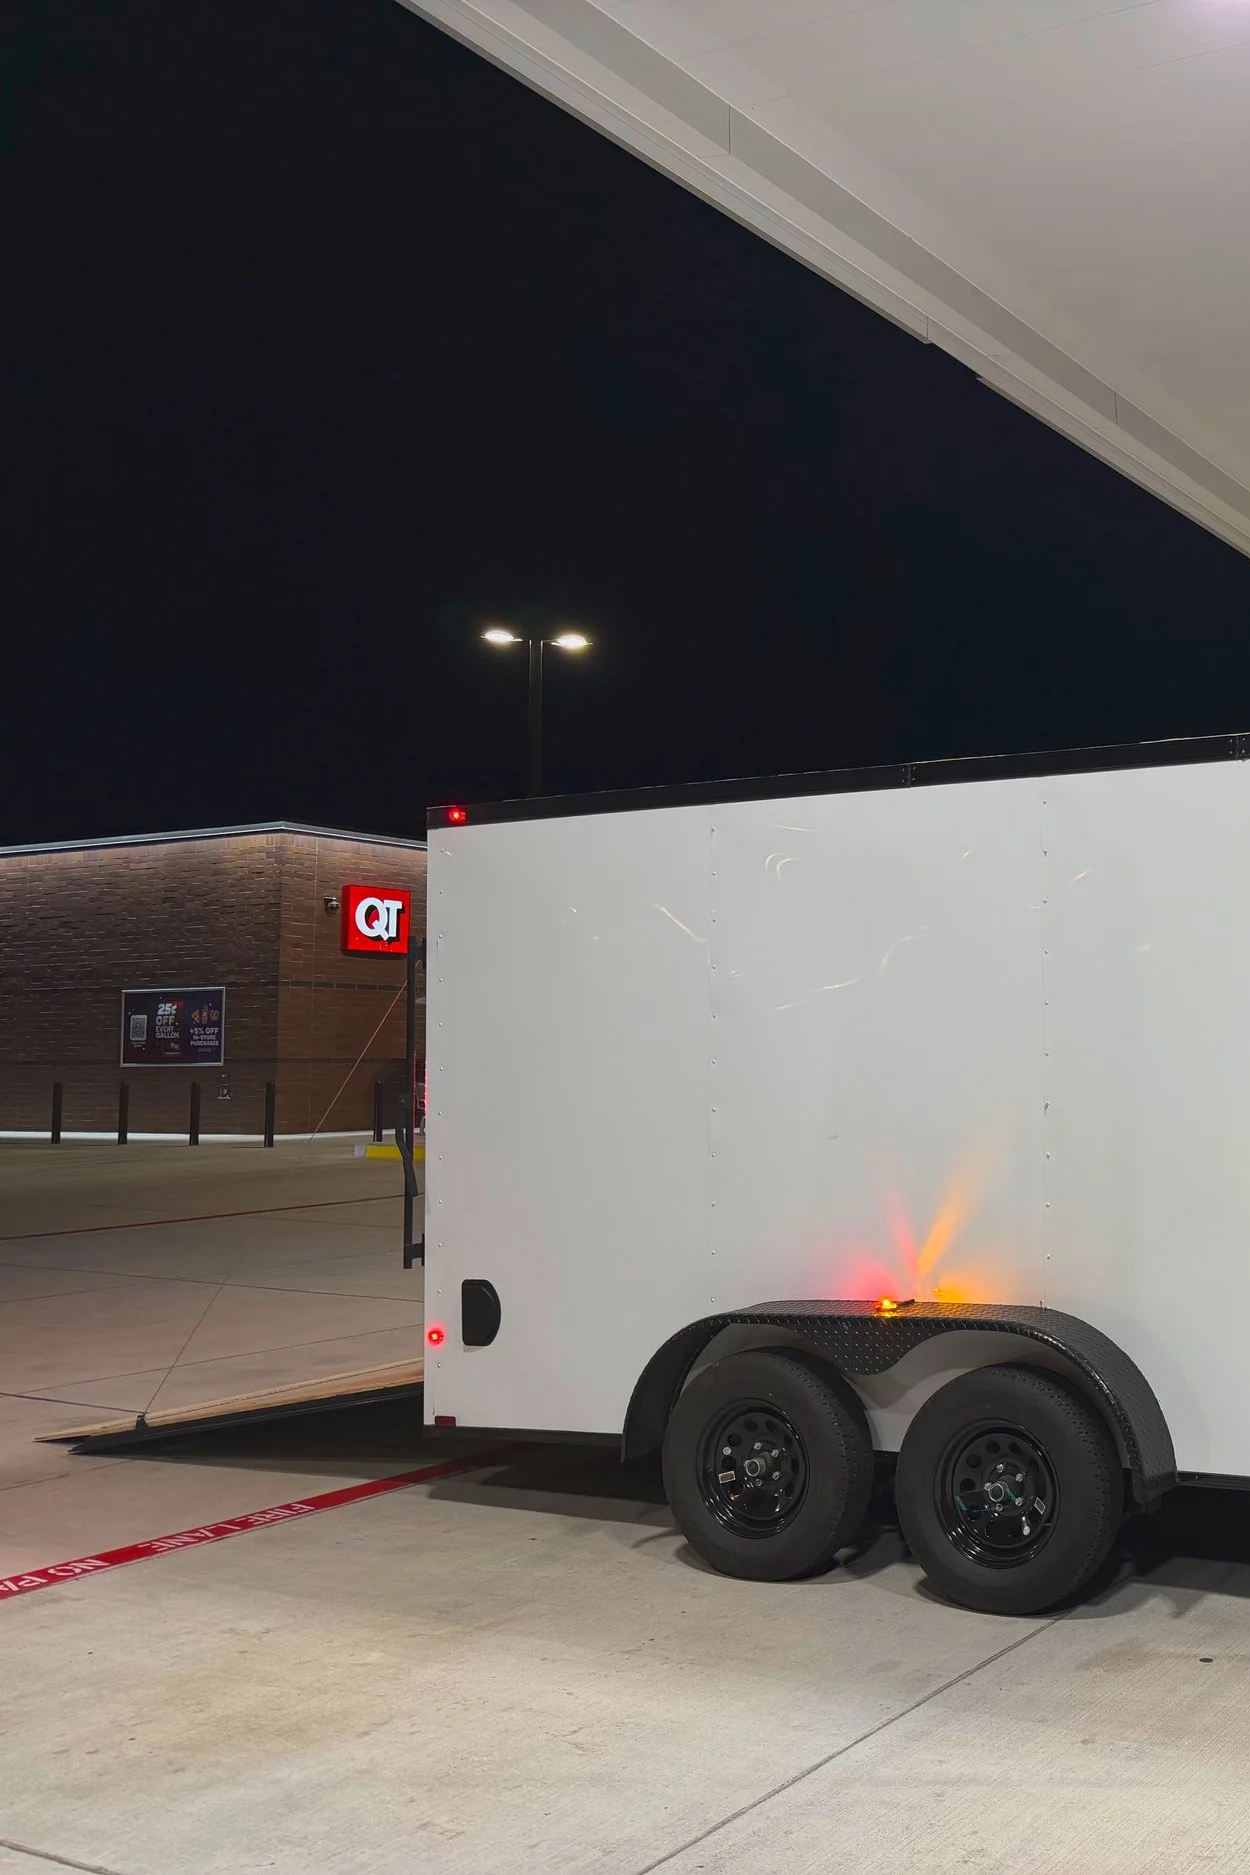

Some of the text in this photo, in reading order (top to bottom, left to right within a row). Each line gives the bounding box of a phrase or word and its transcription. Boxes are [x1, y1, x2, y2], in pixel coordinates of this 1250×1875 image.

[355, 897, 403, 941] QT
[157, 1003, 178, 1015] 25¢
[156, 1016, 175, 1026] OFF
[235, 1503, 315, 1525] FIRE
[137, 1524, 242, 1552] LANE
[47, 1558, 110, 1577] NO
